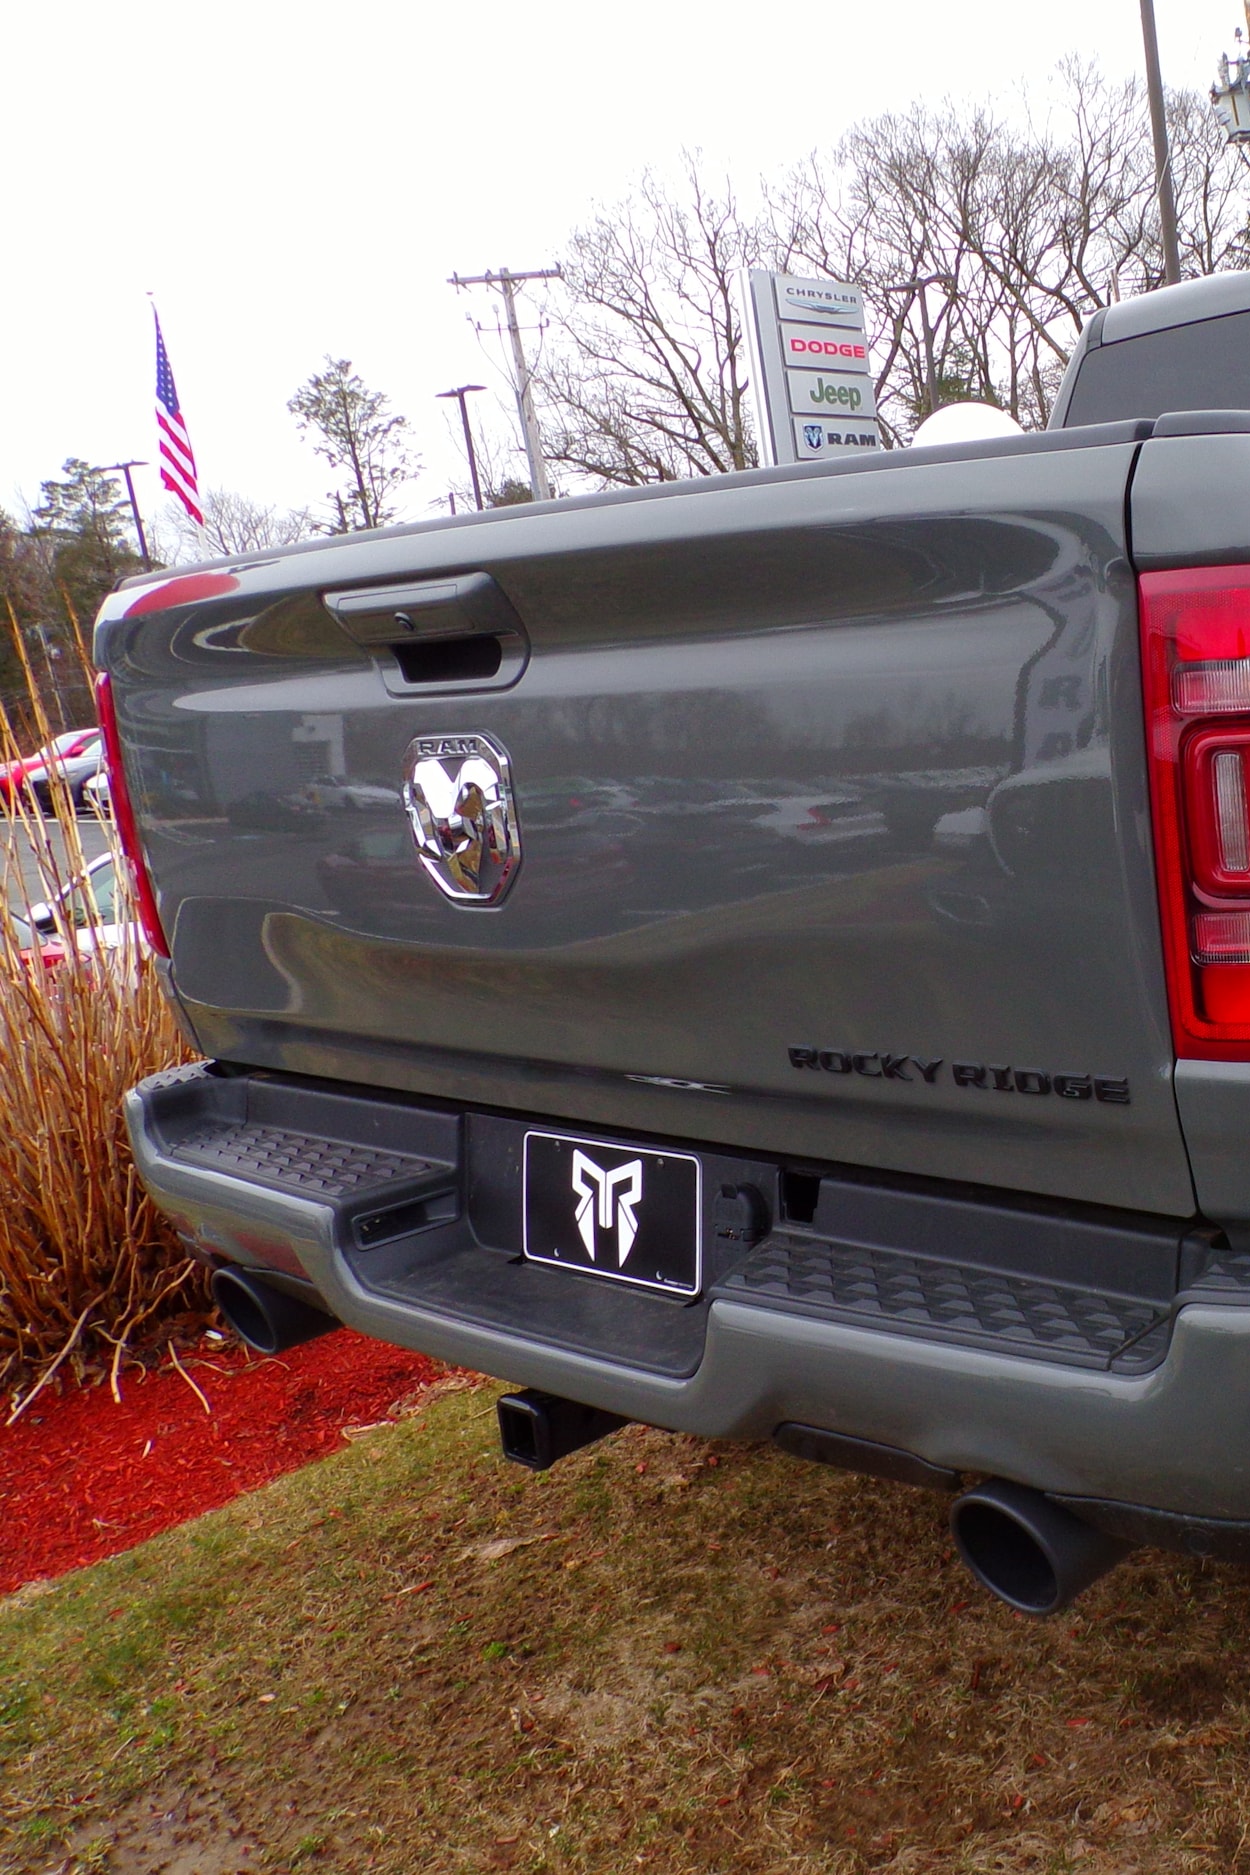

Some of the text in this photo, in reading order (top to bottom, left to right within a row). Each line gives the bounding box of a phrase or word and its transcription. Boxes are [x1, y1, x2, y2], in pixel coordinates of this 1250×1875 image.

[786, 287, 857, 304] CHRYSLER
[790, 338, 866, 359] DODGE
[809, 377, 862, 411] Jeep
[827, 432, 876, 447] RAM
[417, 740, 479, 756] RAM
[787, 1043, 1131, 1105] ROCKY RIDGE
